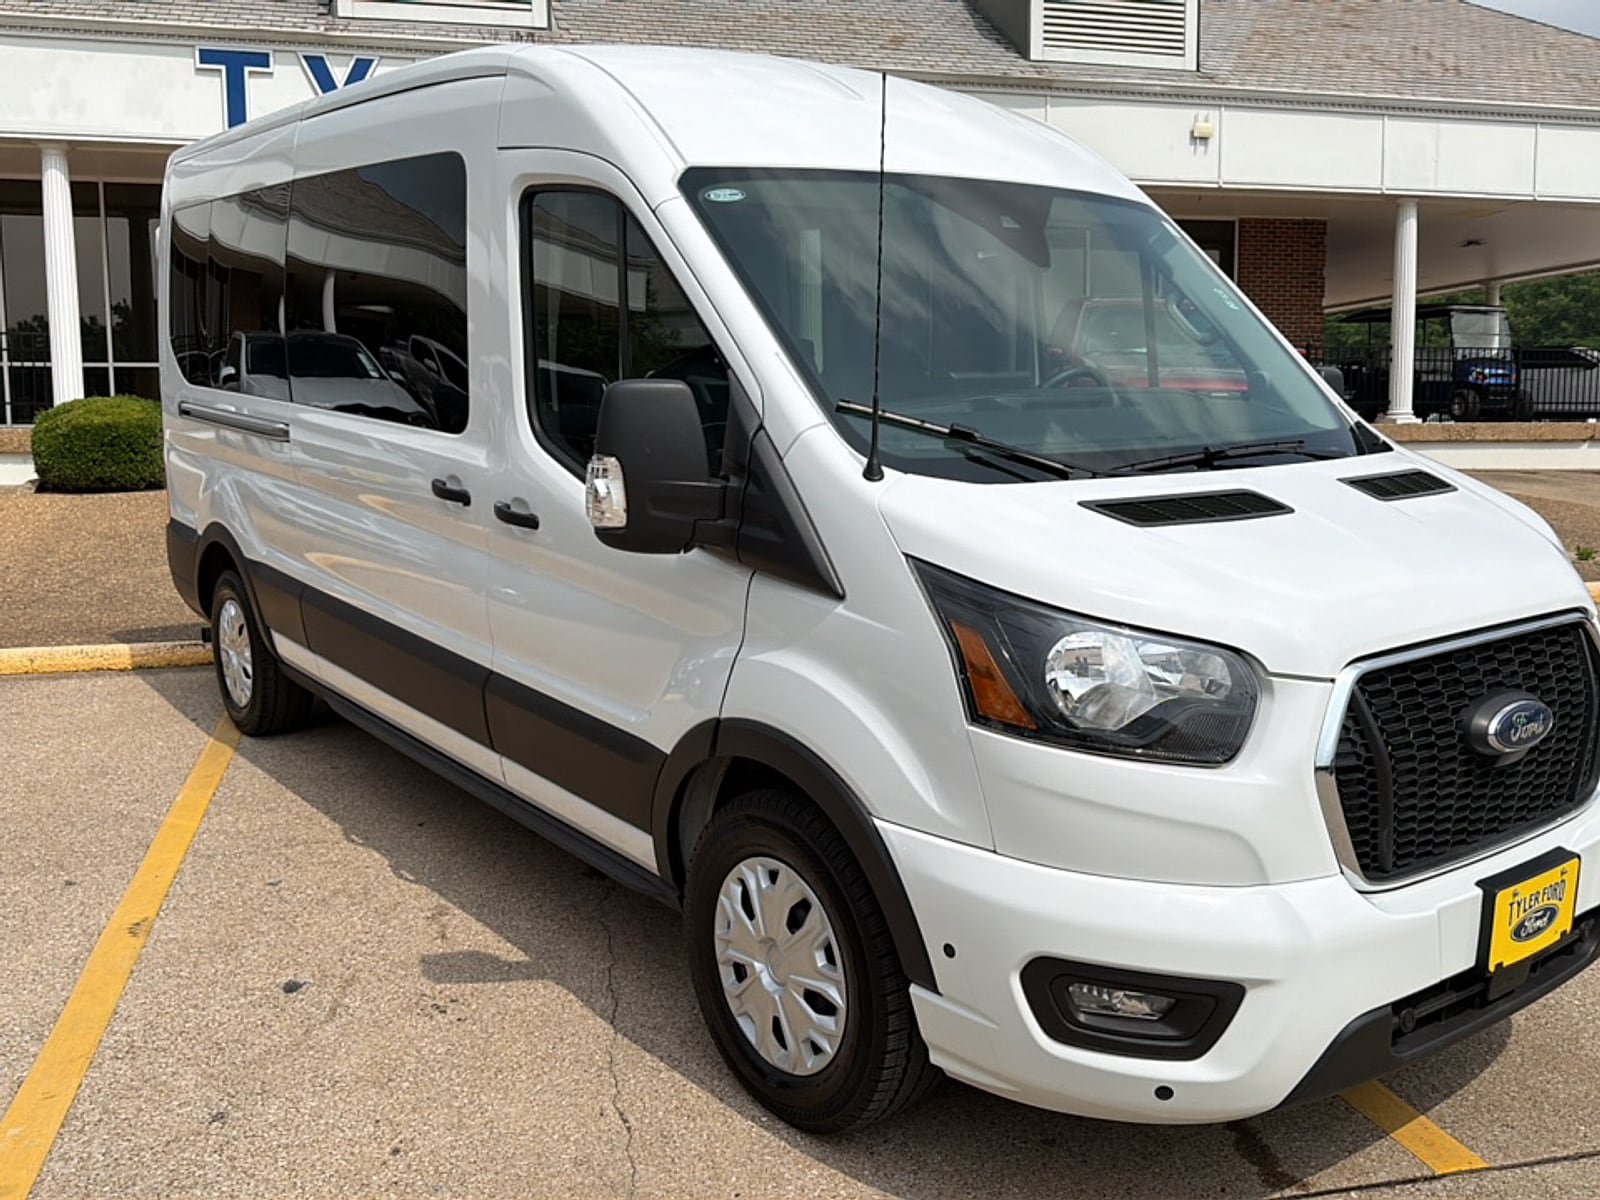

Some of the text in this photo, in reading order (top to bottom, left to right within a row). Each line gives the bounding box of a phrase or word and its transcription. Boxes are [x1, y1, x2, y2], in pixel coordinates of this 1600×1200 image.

[1510, 711, 1545, 742] Ford
[1508, 879, 1566, 927] TYLER FORD
[1520, 909, 1552, 937] Ford
